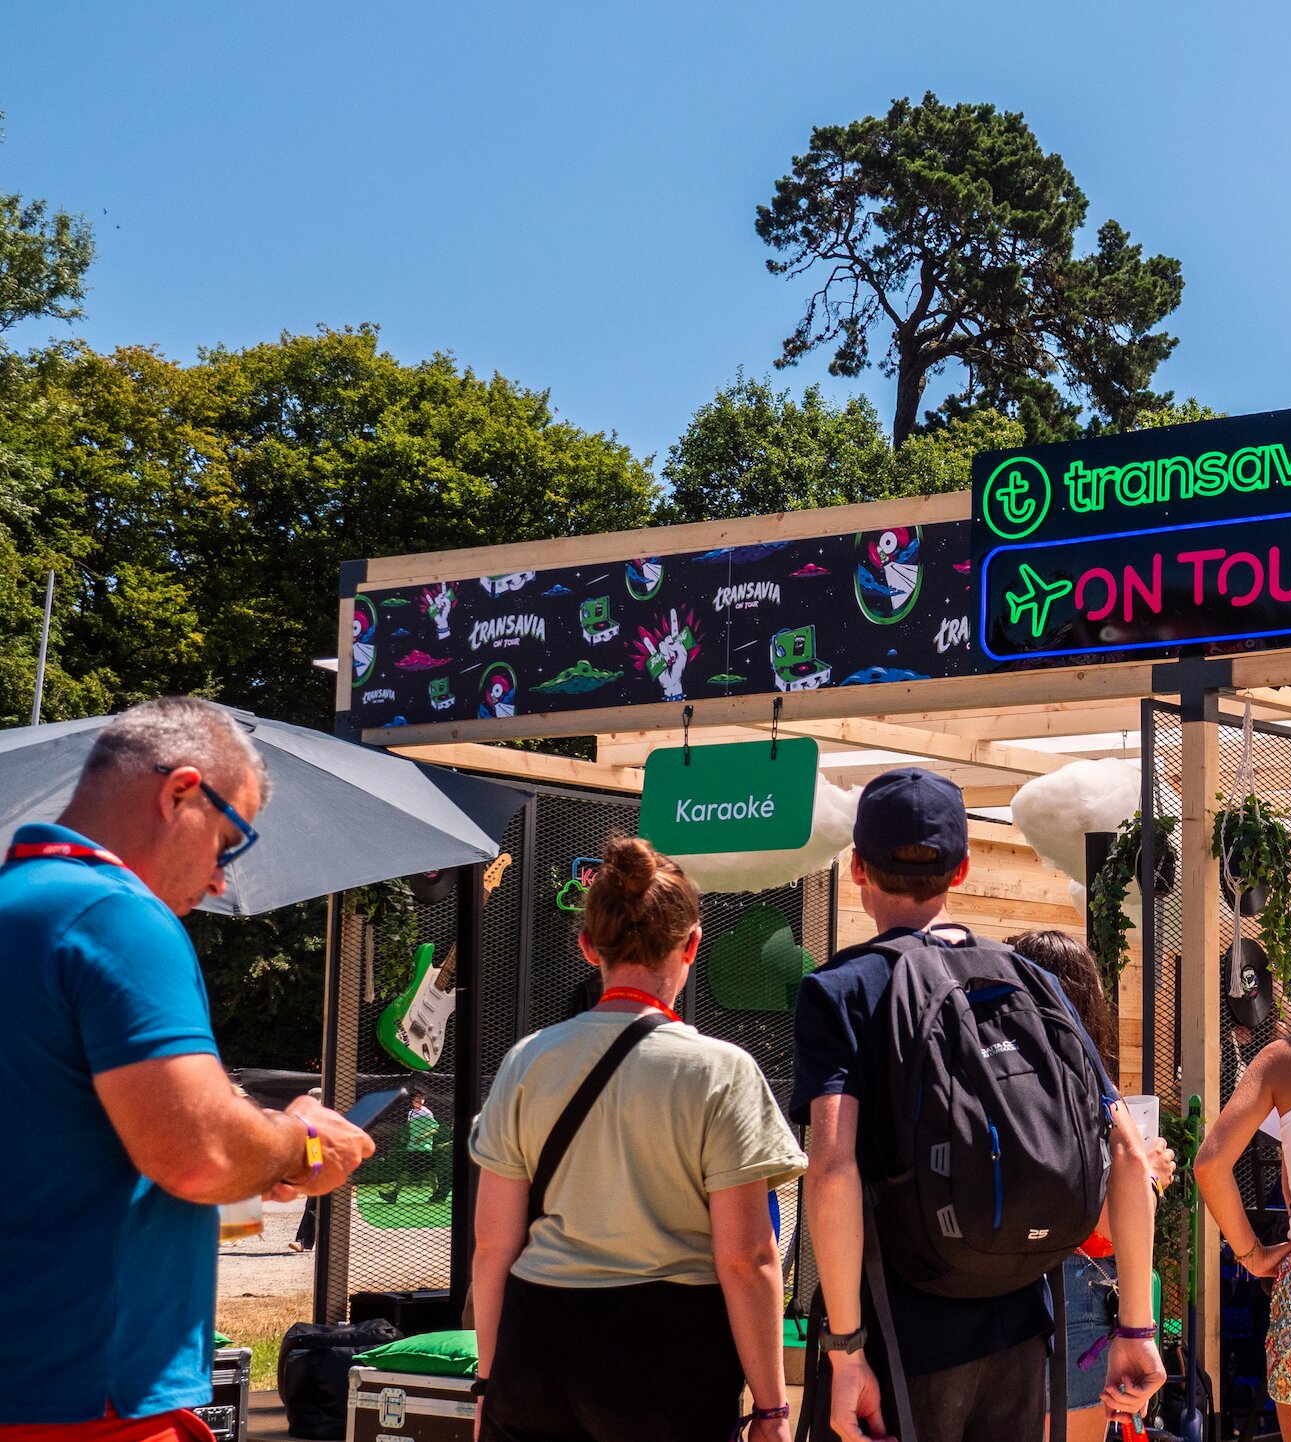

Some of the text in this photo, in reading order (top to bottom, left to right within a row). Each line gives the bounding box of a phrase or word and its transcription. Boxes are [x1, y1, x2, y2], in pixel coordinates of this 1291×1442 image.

[1074, 553, 1162, 623] ON
[675, 793, 775, 823] Karaoké
[1028, 1228, 1050, 1240] 25
